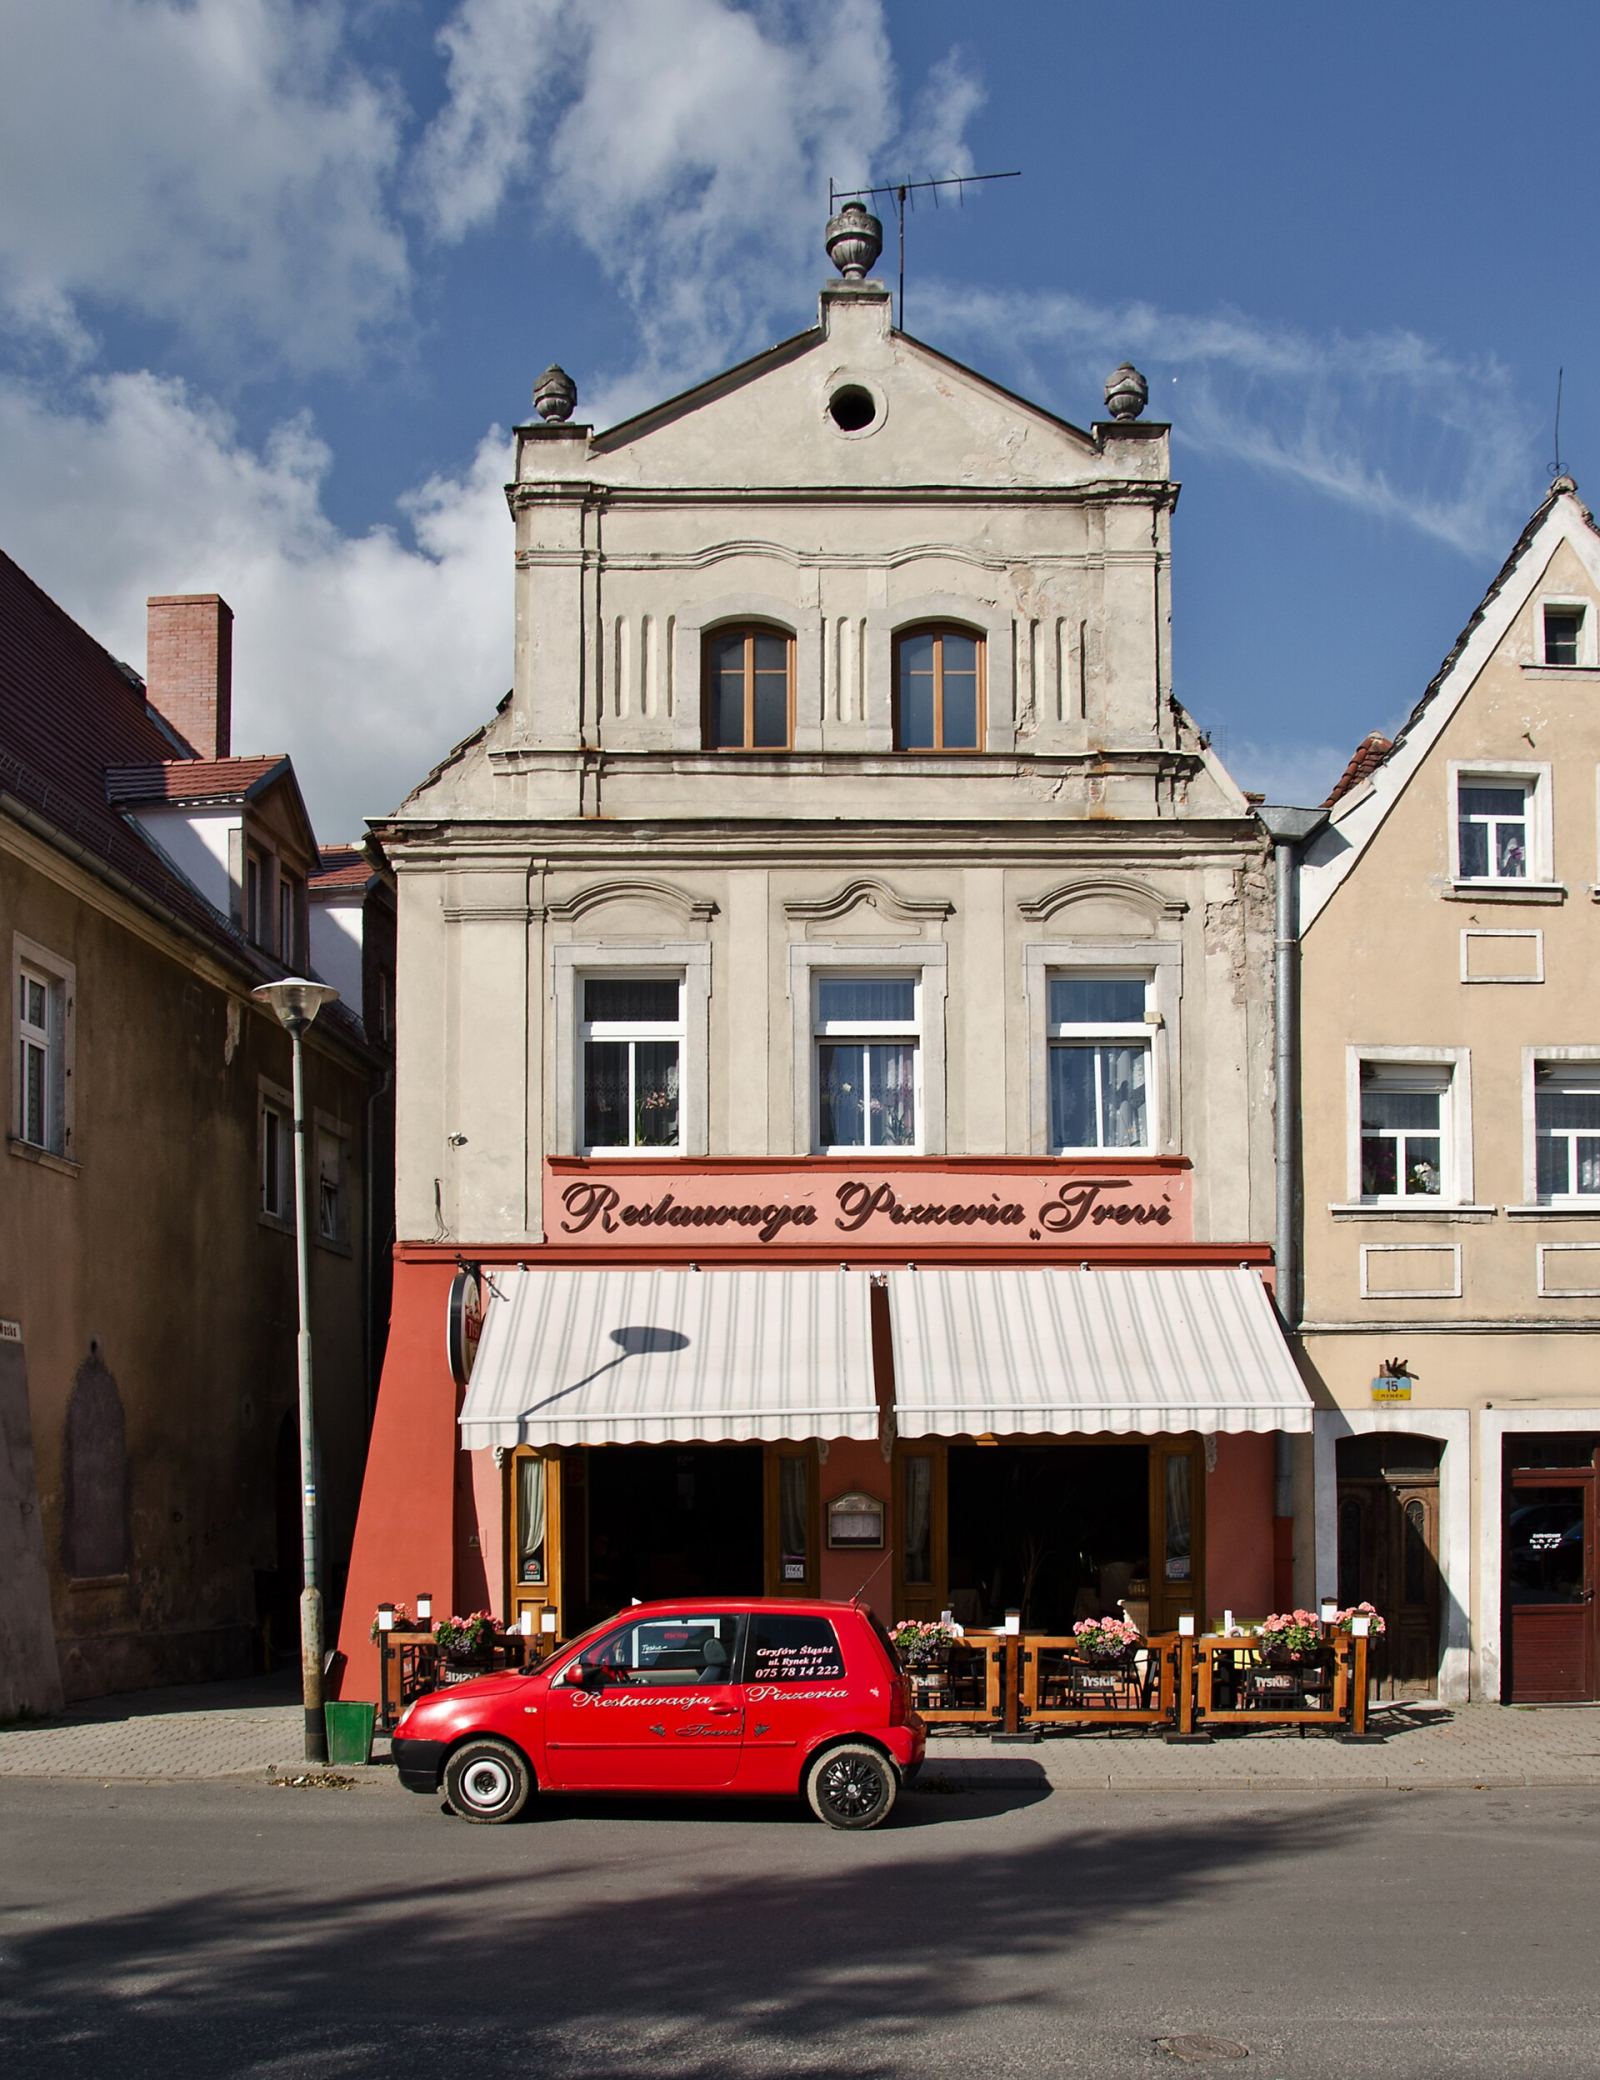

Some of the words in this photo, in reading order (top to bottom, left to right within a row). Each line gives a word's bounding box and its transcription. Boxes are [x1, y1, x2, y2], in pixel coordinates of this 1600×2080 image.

[835, 1180, 1025, 1232] Pizzeria
[1385, 1380, 1399, 1392] 15
[756, 1647, 798, 1657] Gryfów
[800, 1644, 833, 1656] Śląski
[768, 1658, 780, 1666] ul.
[782, 1656, 810, 1667] Rynek
[811, 1656, 823, 1665] 14
[755, 1668, 778, 1679] 075
[781, 1667, 796, 1677] 78
[799, 1666, 814, 1676] 14
[816, 1665, 839, 1676] 222
[1254, 1676, 1291, 1688] TYSKIE
[570, 1690, 712, 1711] Restauracja
[745, 1685, 849, 1703] Pizzeria
